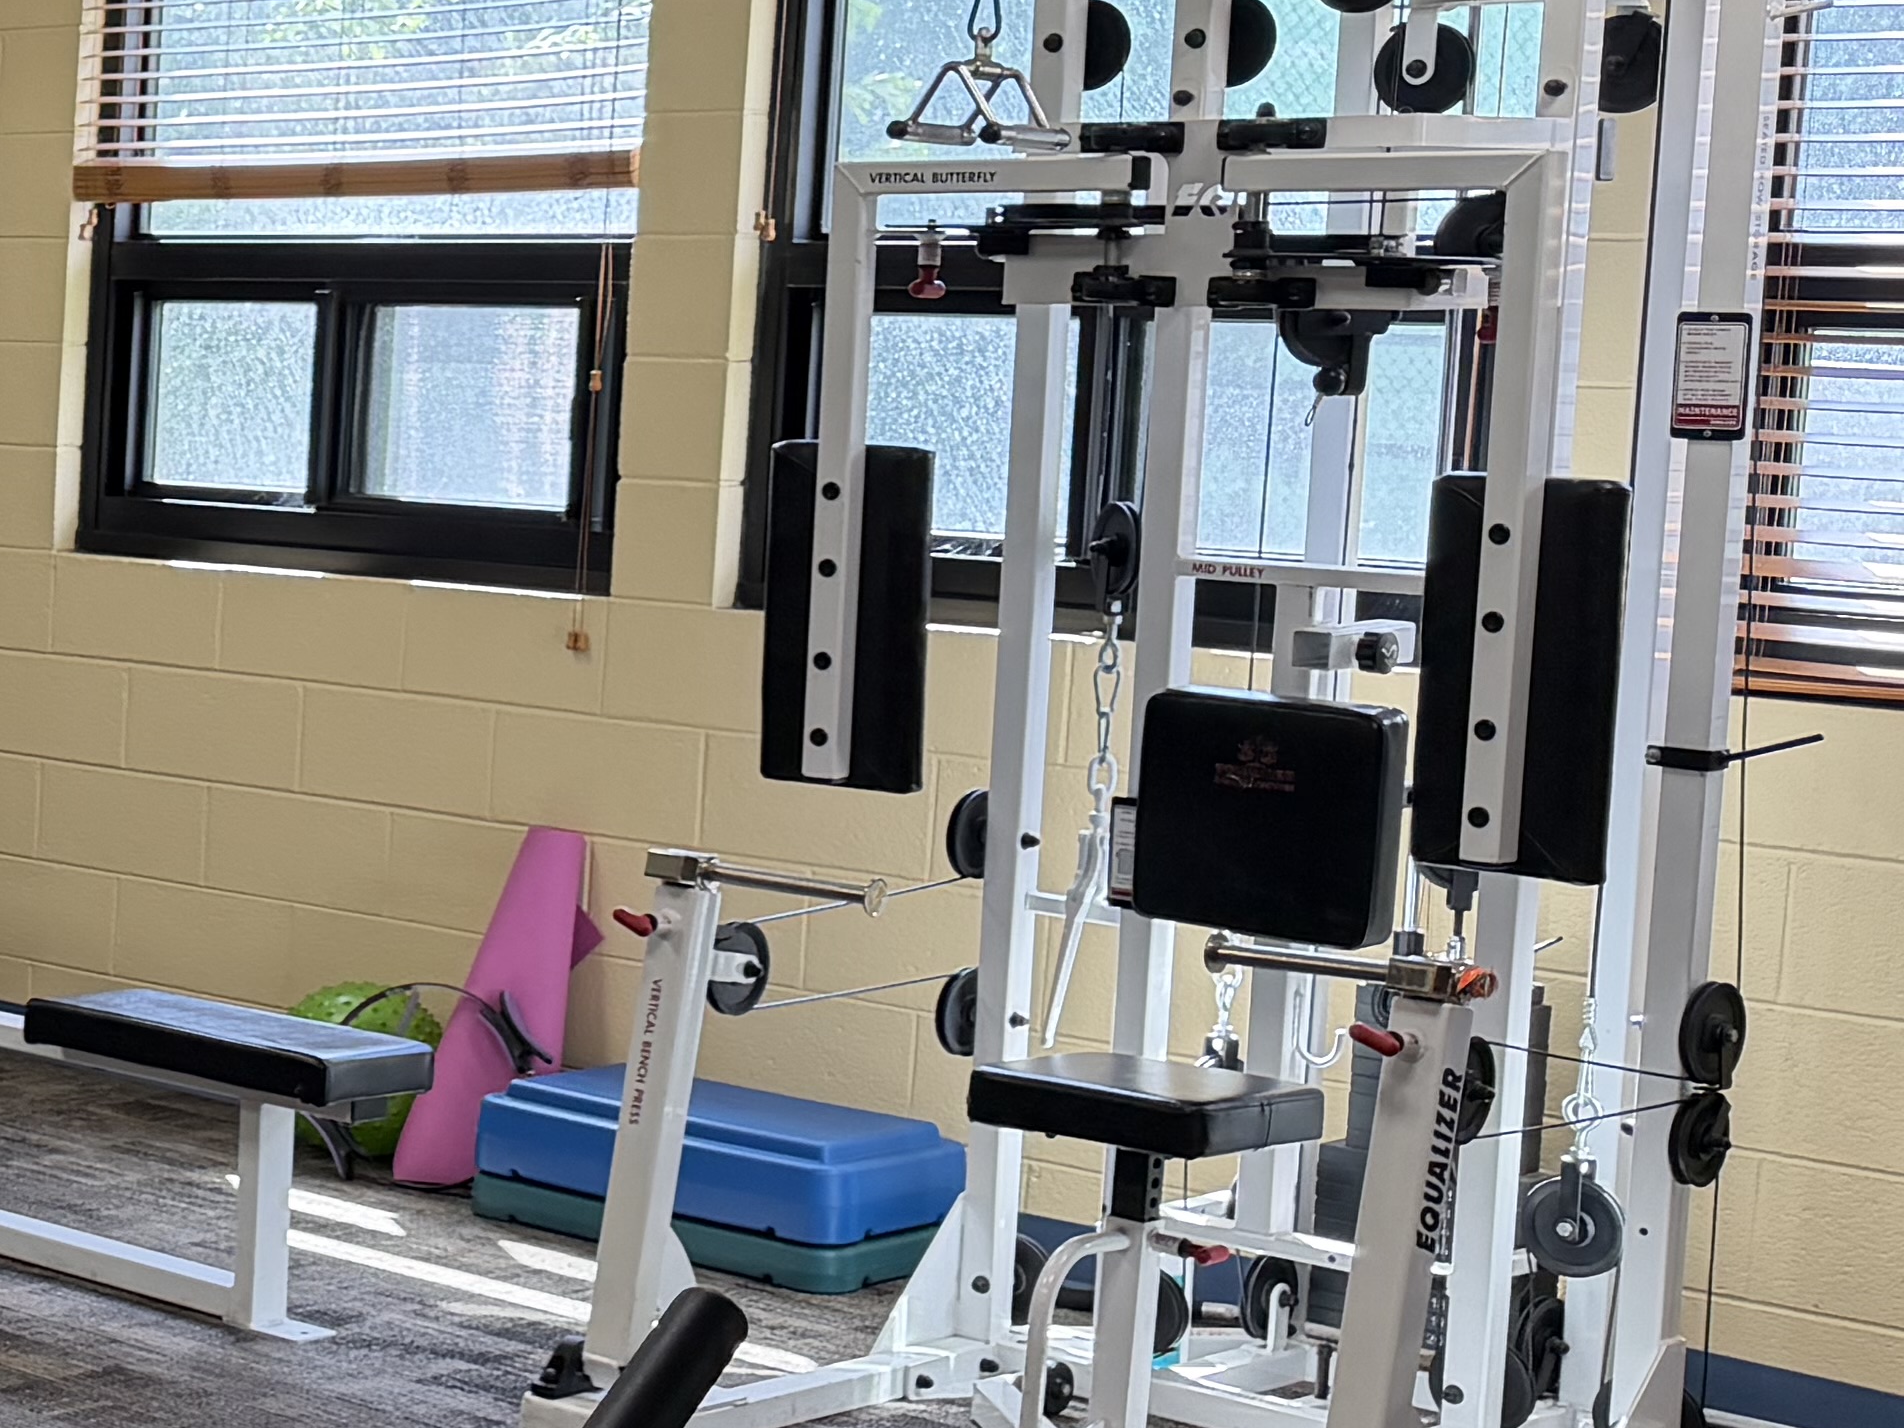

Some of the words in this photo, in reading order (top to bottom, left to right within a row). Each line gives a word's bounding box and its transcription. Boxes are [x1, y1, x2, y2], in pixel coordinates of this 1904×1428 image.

[869, 172, 926, 184] VERTICAL
[932, 171, 998, 184] BUTTERFLY
[1222, 565, 1265, 579] PULLEY
[643, 978, 663, 1035] VERTICAL
[635, 1041, 652, 1084] BENCH
[628, 1088, 645, 1125] PRESS
[1416, 1068, 1464, 1254] EQUALIZER
